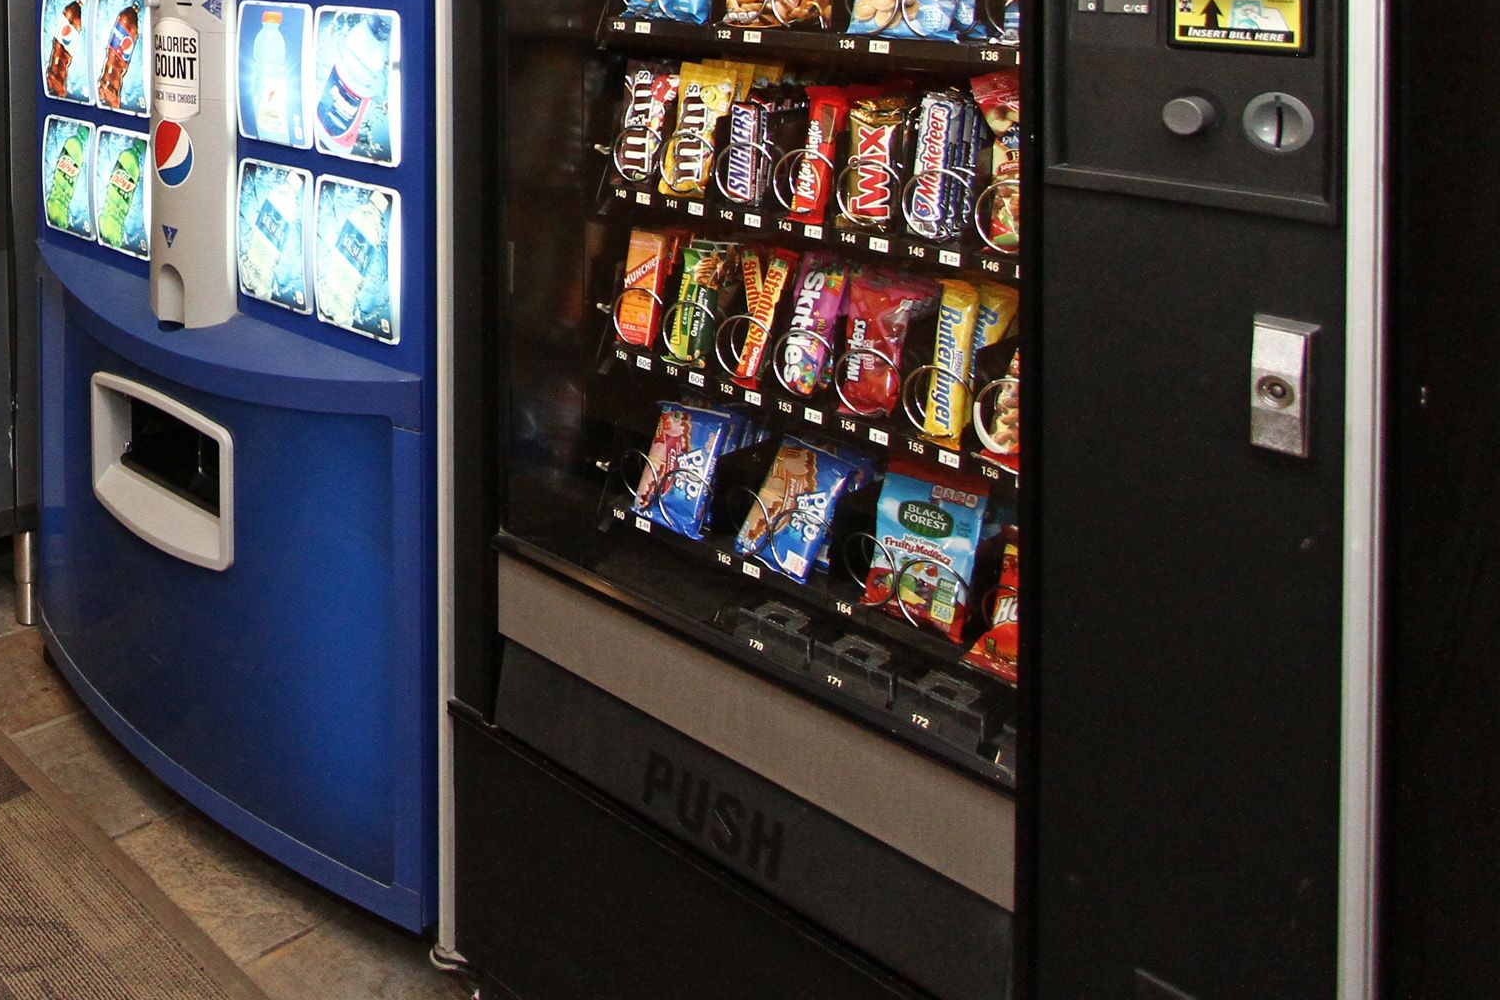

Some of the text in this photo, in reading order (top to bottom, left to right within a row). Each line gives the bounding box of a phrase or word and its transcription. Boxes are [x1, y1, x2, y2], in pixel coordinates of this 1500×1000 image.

[1087, 3, 1095, 11] 0
[1123, 3, 1147, 13] C/CE
[613, 22, 626, 30] 130
[717, 30, 731, 39] 132
[1187, 27, 1285, 42] INSERT BILL HERE
[154, 34, 197, 54] CALORIES
[839, 39, 855, 49] 134
[980, 51, 999, 61] 136
[154, 54, 197, 81] COUNT
[728, 105, 752, 198] SNICKERS
[615, 189, 627, 198] 140
[666, 199, 678, 208] 141
[720, 209, 733, 220] 142
[778, 220, 792, 232] 143
[840, 232, 856, 244] 144
[908, 245, 925, 257] 145
[981, 259, 999, 272] 146
[743, 260, 760, 312] Starbu
[783, 270, 826, 383] Skittles
[615, 350, 628, 361] 150
[666, 366, 678, 376] 151
[720, 383, 733, 395] 152
[777, 402, 792, 413] 153
[840, 420, 856, 432] 154
[907, 441, 924, 454] 155
[981, 465, 999, 479] 156
[613, 508, 625, 520] 160
[907, 503, 945, 521] BLACK
[903, 511, 949, 531] FOREST
[717, 552, 732, 565] 162
[835, 602, 852, 616] 164
[749, 638, 764, 651] 170
[826, 674, 842, 688] 171
[911, 713, 930, 729] 172
[642, 752, 786, 882] PUSH
